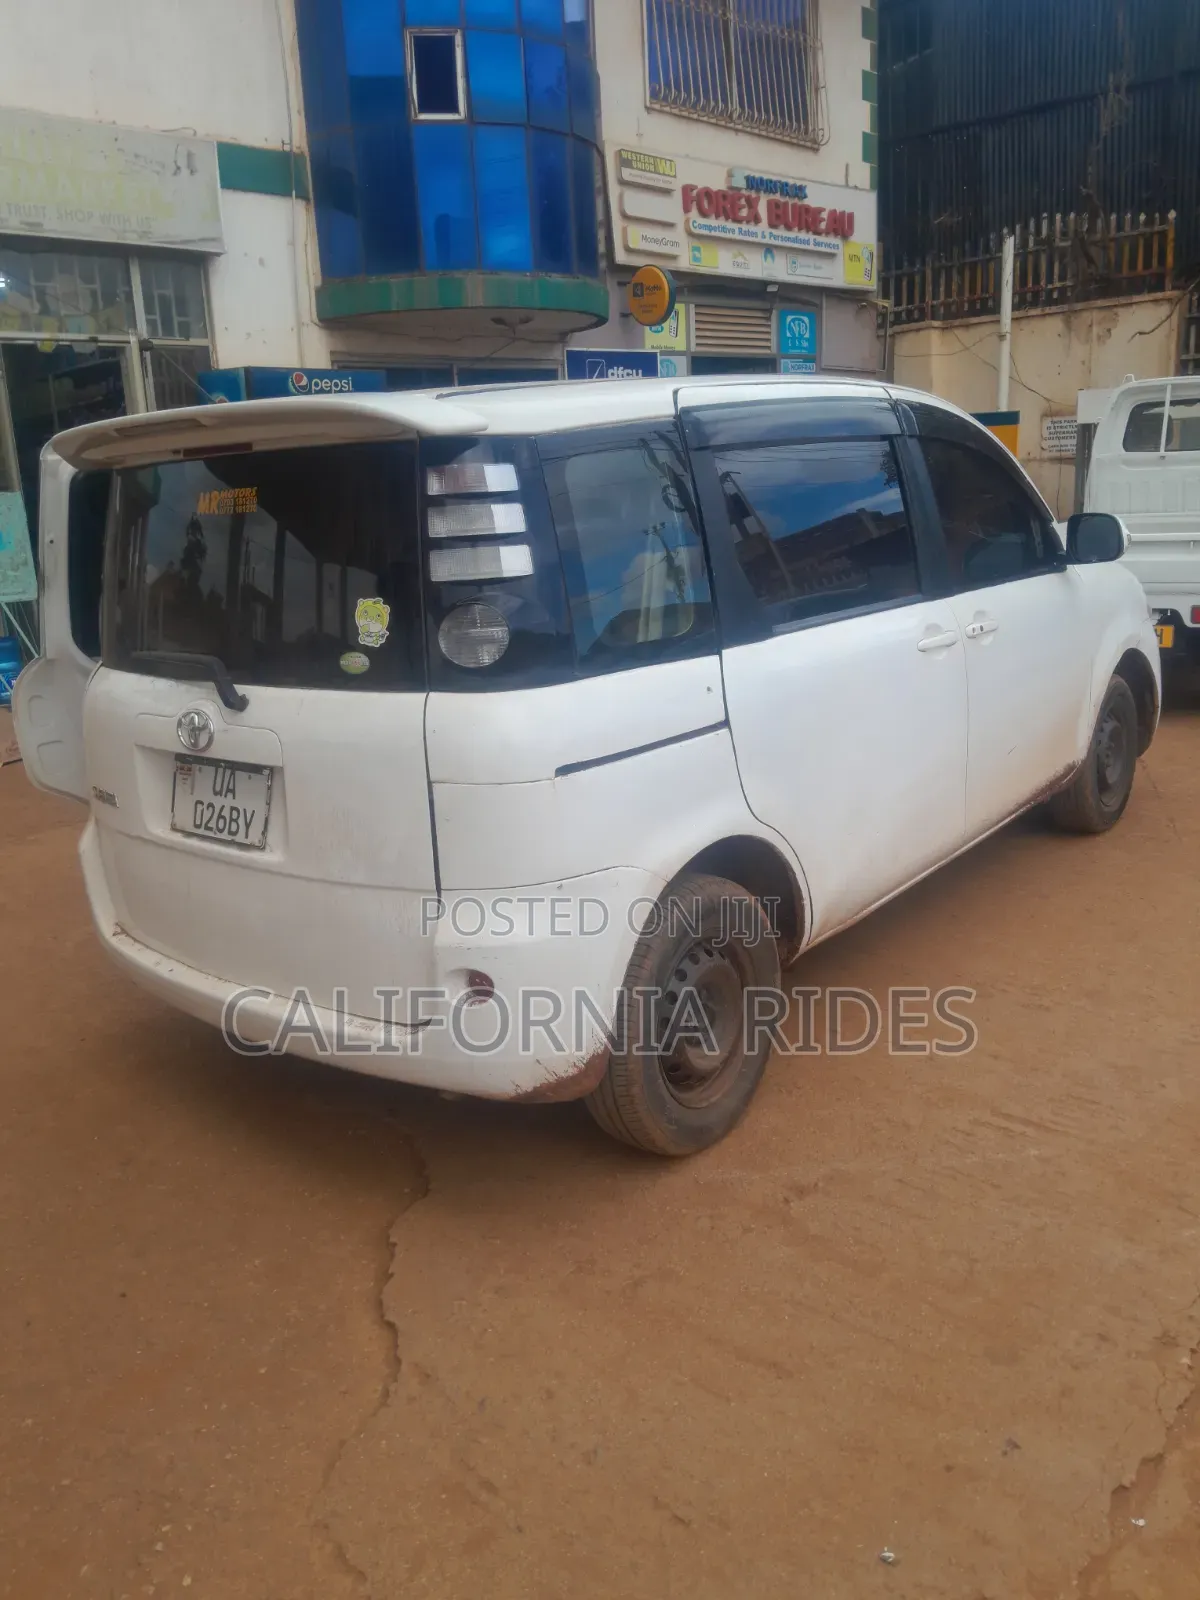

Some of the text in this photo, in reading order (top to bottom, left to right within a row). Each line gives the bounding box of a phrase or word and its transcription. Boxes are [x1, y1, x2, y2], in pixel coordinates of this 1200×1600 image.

[621, 150, 655, 166] WESTERN
[632, 160, 655, 172] UNION
[56, 207, 94, 223] SHOP
[99, 211, 132, 229] WITH
[681, 183, 854, 239] FOREX BUREAU
[641, 233, 680, 248] MoneyGram
[691, 219, 840, 250] Competitive Rates & Personalised Services
[608, 366, 642, 379] dfcu
[311, 376, 353, 393] pepsi
[220, 487, 258, 499] MOTORS
[212, 764, 236, 800] UA
[193, 799, 256, 840] 026BY
